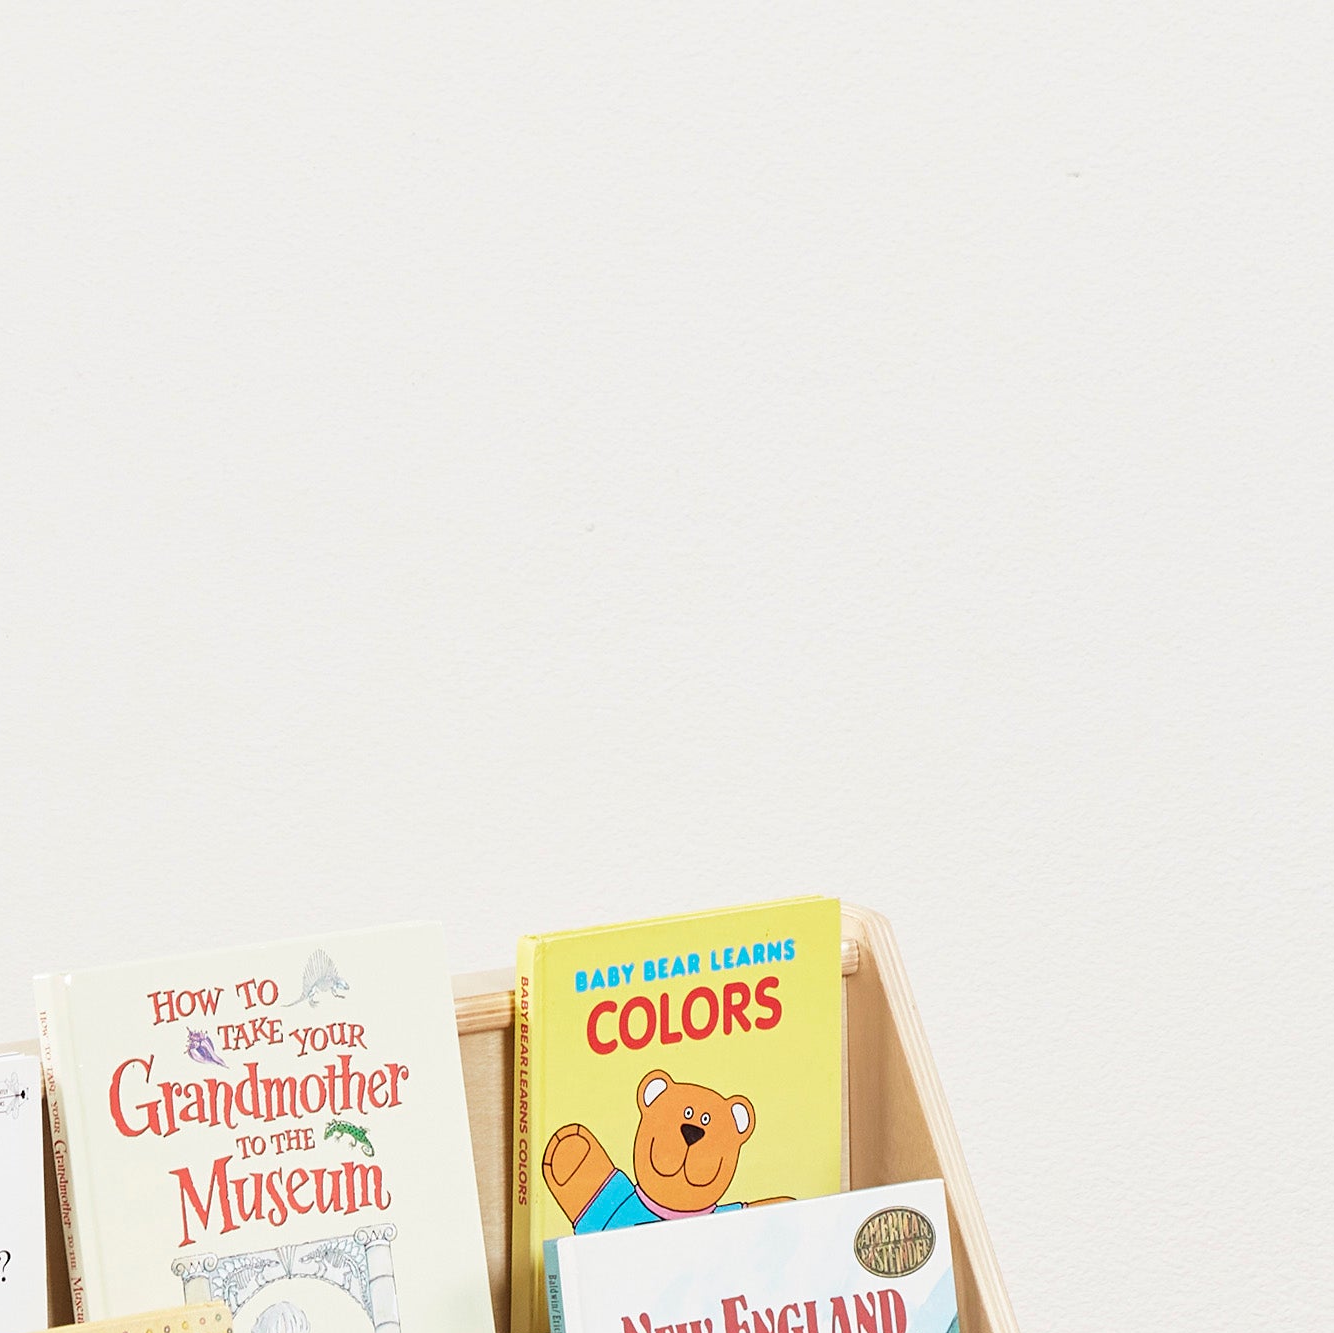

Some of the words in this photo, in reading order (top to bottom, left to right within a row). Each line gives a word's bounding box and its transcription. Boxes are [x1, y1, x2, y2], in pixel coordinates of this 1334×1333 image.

[575, 960, 635, 993] BABY
[643, 952, 700, 981] BEAR
[711, 938, 796, 972] LEARNS
[236, 979, 278, 1011] TO
[519, 976, 530, 1024] BABY
[587, 976, 782, 1055] COLORS
[218, 1018, 283, 1052] TAKE
[289, 1024, 367, 1057] YOUR
[519, 1025, 530, 1069] BEAR
[109, 1055, 409, 1138] Grandmother
[518, 1071, 529, 1134] LEARNS
[237, 1135, 266, 1159] TO
[271, 1128, 316, 1154] THE
[518, 1139, 529, 1206] COLORS
[169, 1156, 391, 1247] Museum
